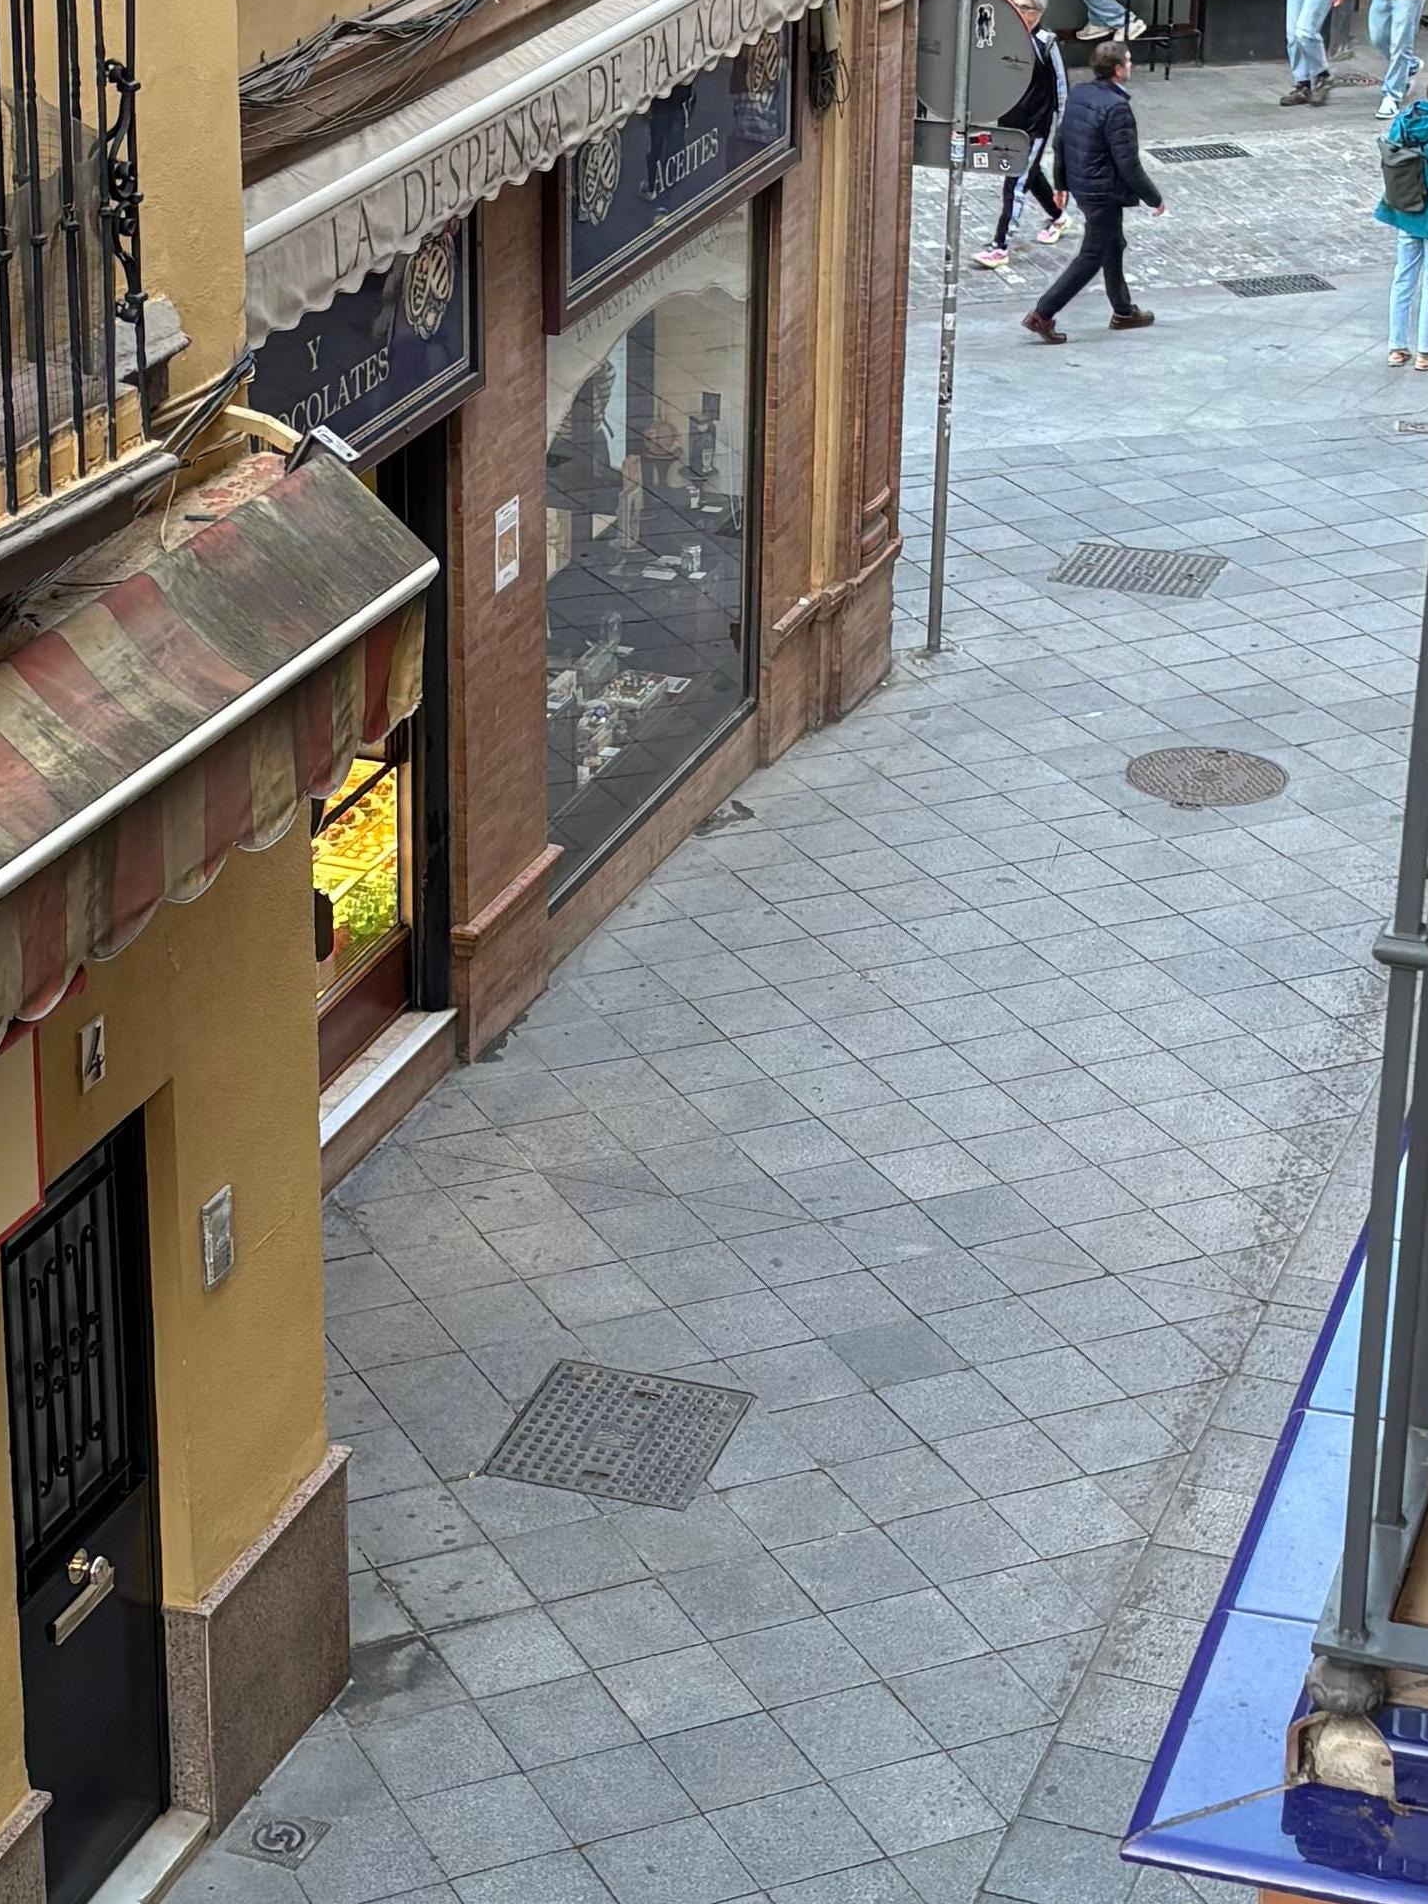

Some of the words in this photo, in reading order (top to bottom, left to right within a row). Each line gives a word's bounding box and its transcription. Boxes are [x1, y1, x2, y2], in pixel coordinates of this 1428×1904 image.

[331, 198, 374, 281] LA
[403, 90, 563, 236] DESPENSA
[587, 52, 623, 125] DE
[650, 126, 720, 200] ACEITES
[306, 334, 322, 373] Y
